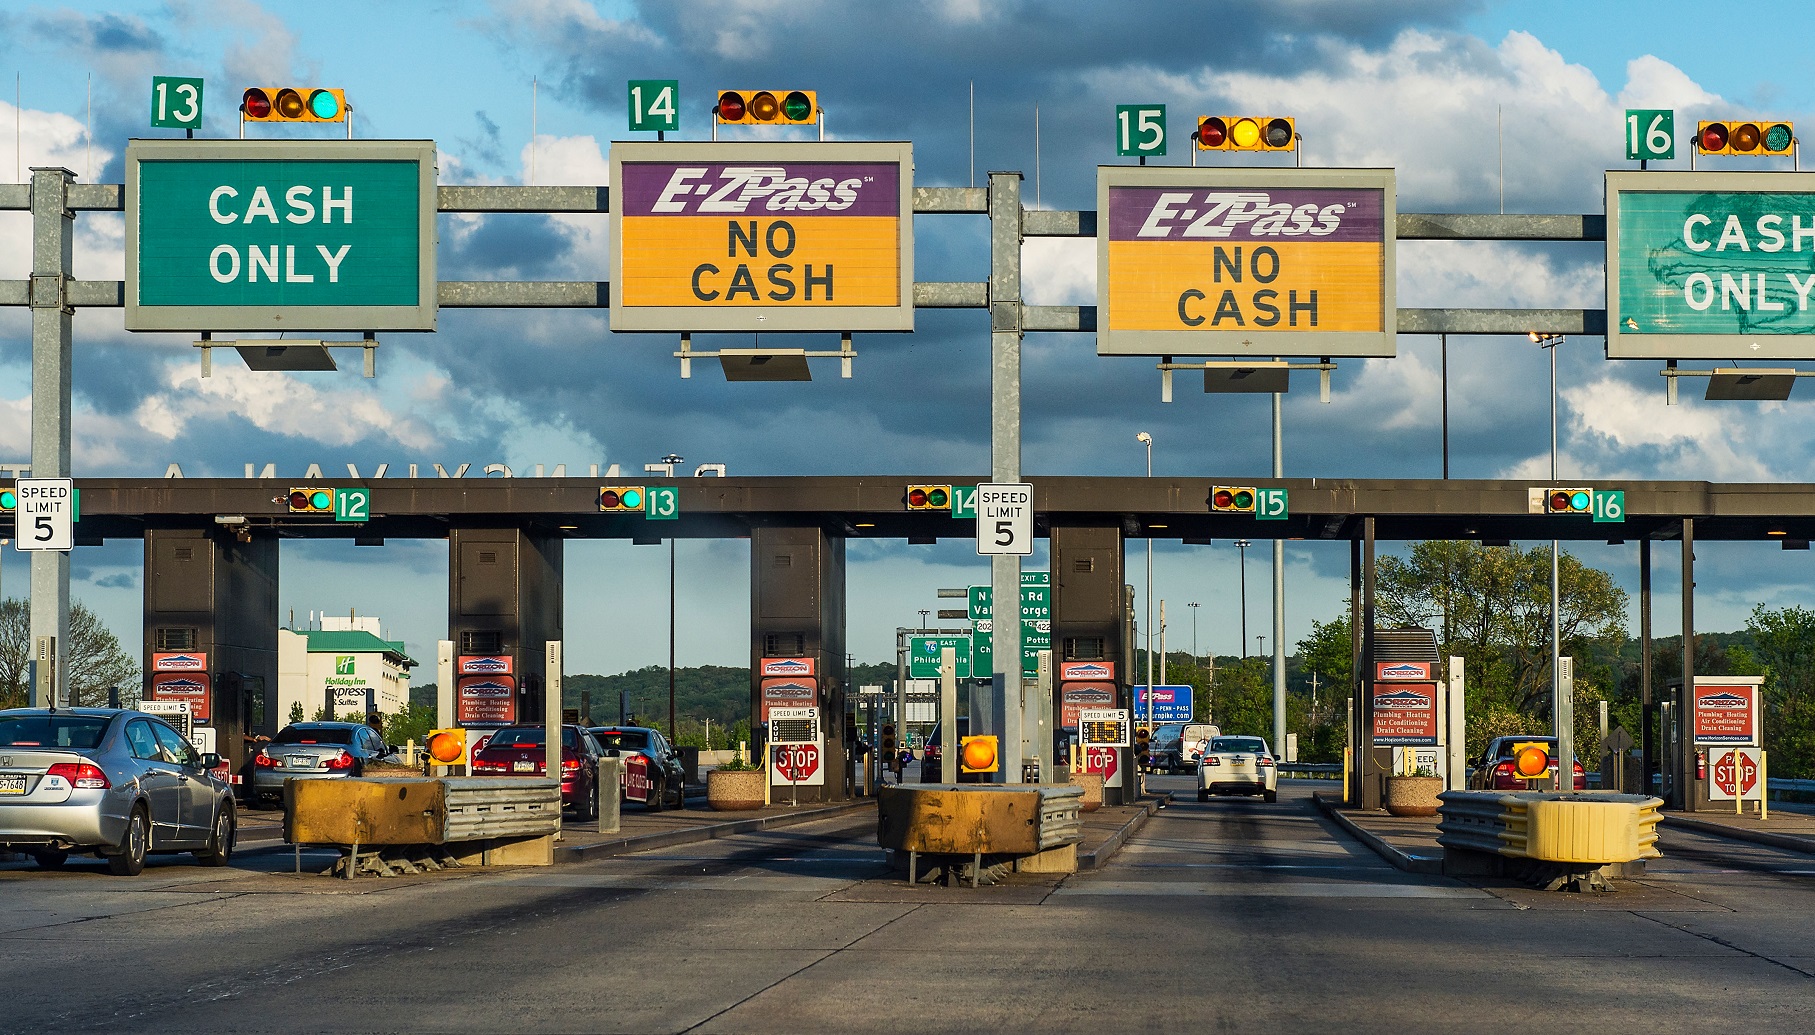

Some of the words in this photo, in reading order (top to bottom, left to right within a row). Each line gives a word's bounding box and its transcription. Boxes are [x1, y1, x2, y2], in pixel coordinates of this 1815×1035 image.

[156, 83, 198, 122] 13
[632, 86, 675, 124] 14
[1119, 110, 1163, 150] 15
[1628, 114, 1671, 154] 16
[651, 167, 862, 213] E-ZPass
[209, 186, 353, 225] CASH
[1137, 192, 1345, 237] E-ZPass
[728, 220, 796, 258] NO
[1683, 214, 1815, 253] CASH
[209, 244, 352, 283] ONLY
[1213, 246, 1280, 283] NO
[691, 264, 834, 301] CASH
[1684, 272, 1815, 311] ONLY
[1178, 289, 1318, 327] CASH
[21, 487, 67, 499] SPEED
[340, 492, 366, 517] 12
[649, 490, 675, 516] 13
[955, 490, 977, 514] 14
[982, 493, 1028, 503] SPEED
[1258, 491, 1285, 516] 15
[26, 502, 62, 513] LIMIT
[987, 507, 1022, 518] LIMIT
[1596, 493, 1621, 519] 16
[34, 517, 54, 542] 5
[994, 521, 1014, 546] 5
[978, 592, 986, 601] N
[1028, 592, 1043, 601] Rd
[1021, 606, 1048, 617] orge
[325, 677, 353, 686] Holiday
[354, 677, 366, 685] Inn
[179, 703, 187, 712] 5
[808, 709, 815, 718] 5
[1118, 711, 1125, 720] 5
[1406, 711, 1431, 719] Heating
[1092, 721, 1117, 741] 15
[1388, 719, 1428, 727] Conditioning
[1396, 727, 1424, 735] Cleaning
[778, 750, 817, 767] STOP
